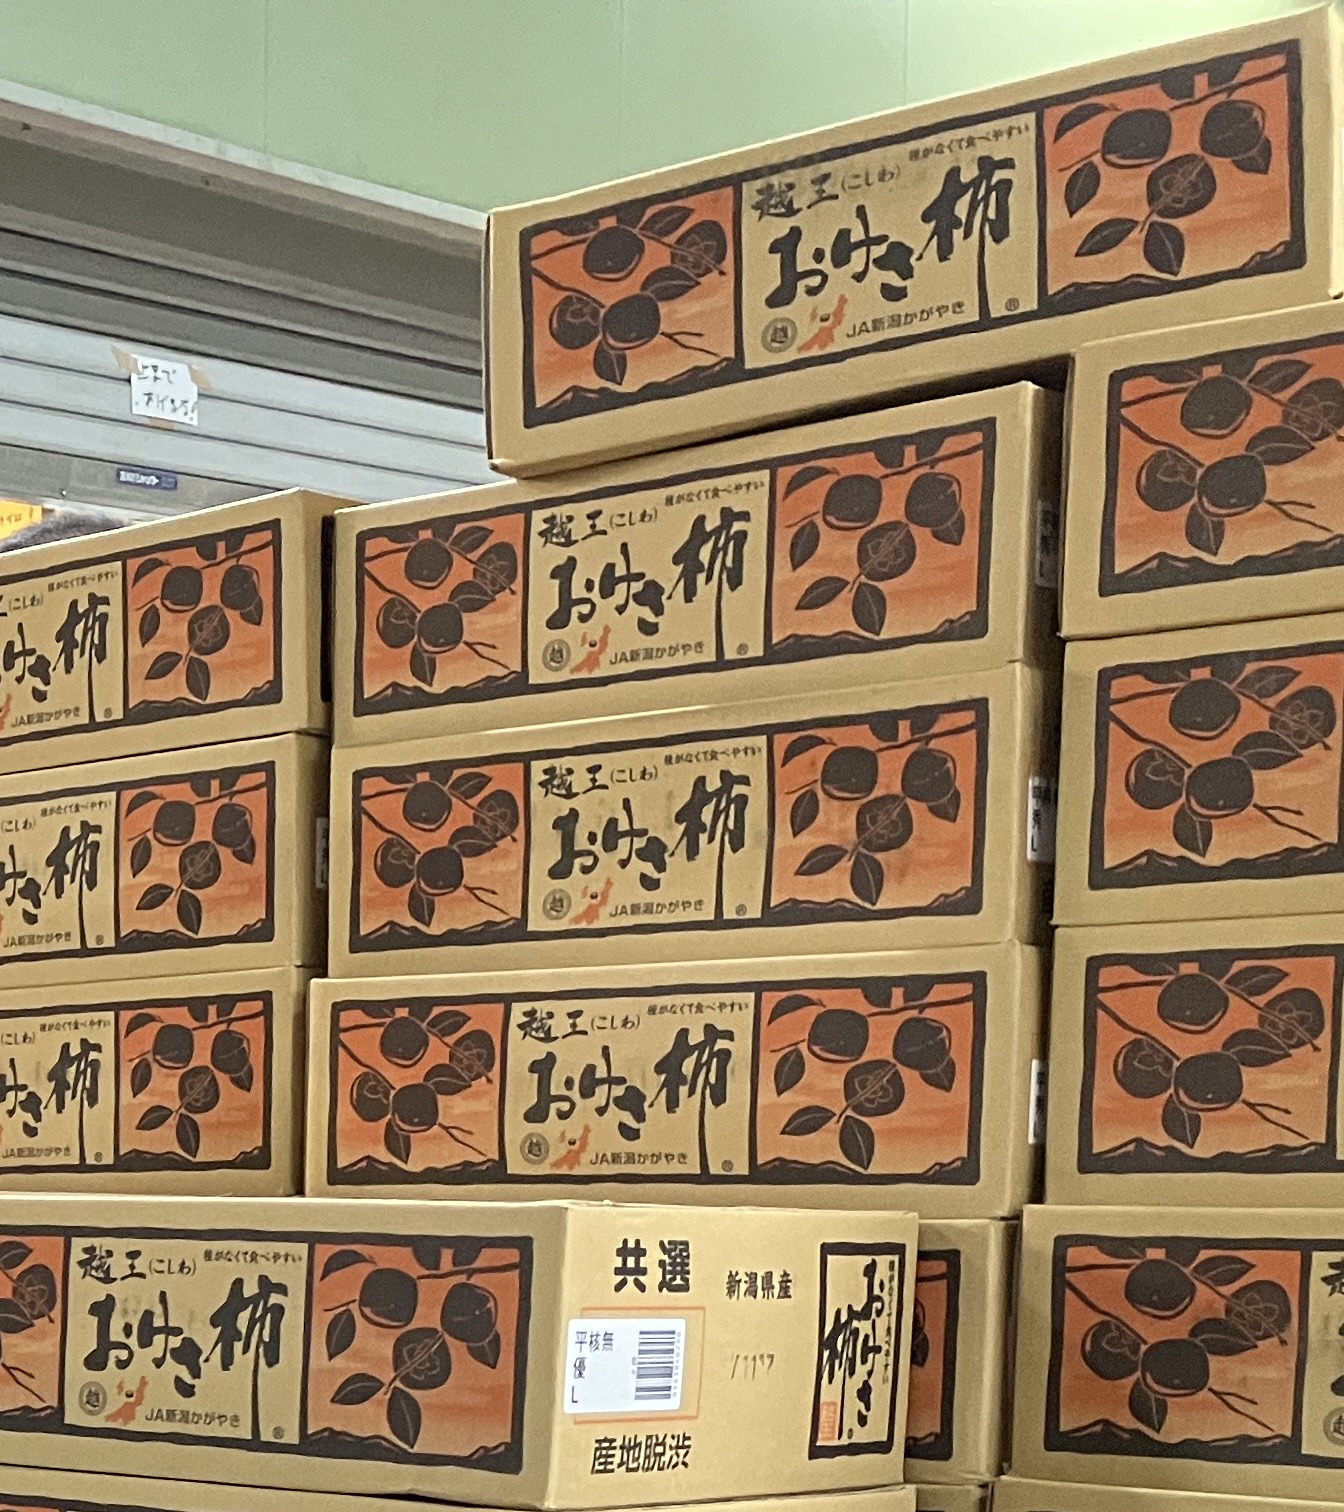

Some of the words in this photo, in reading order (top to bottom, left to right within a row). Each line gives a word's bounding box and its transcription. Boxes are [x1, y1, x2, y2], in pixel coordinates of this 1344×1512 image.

[765, 154, 1016, 322] おけさ柿
[537, 508, 657, 548] 越王(こしわ)
[545, 506, 750, 662] おけさ柿
[538, 763, 659, 800] 越王(こしわ)
[547, 769, 751, 920] おけさ柿
[516, 1008, 639, 1043] 越王(こしわ)
[523, 1023, 734, 1174] おけさ柿
[76, 1244, 196, 1284] 越王(こしわ)
[614, 1238, 691, 1294] 共選
[725, 1270, 794, 1301] 新潟県産
[83, 1274, 288, 1441] おけさ柿
[573, 1357, 587, 1380] 優
[571, 1386, 579, 1404] L
[144, 1408, 240, 1428] JA新潟かがやき
[591, 1433, 692, 1475] 産地脱渋
